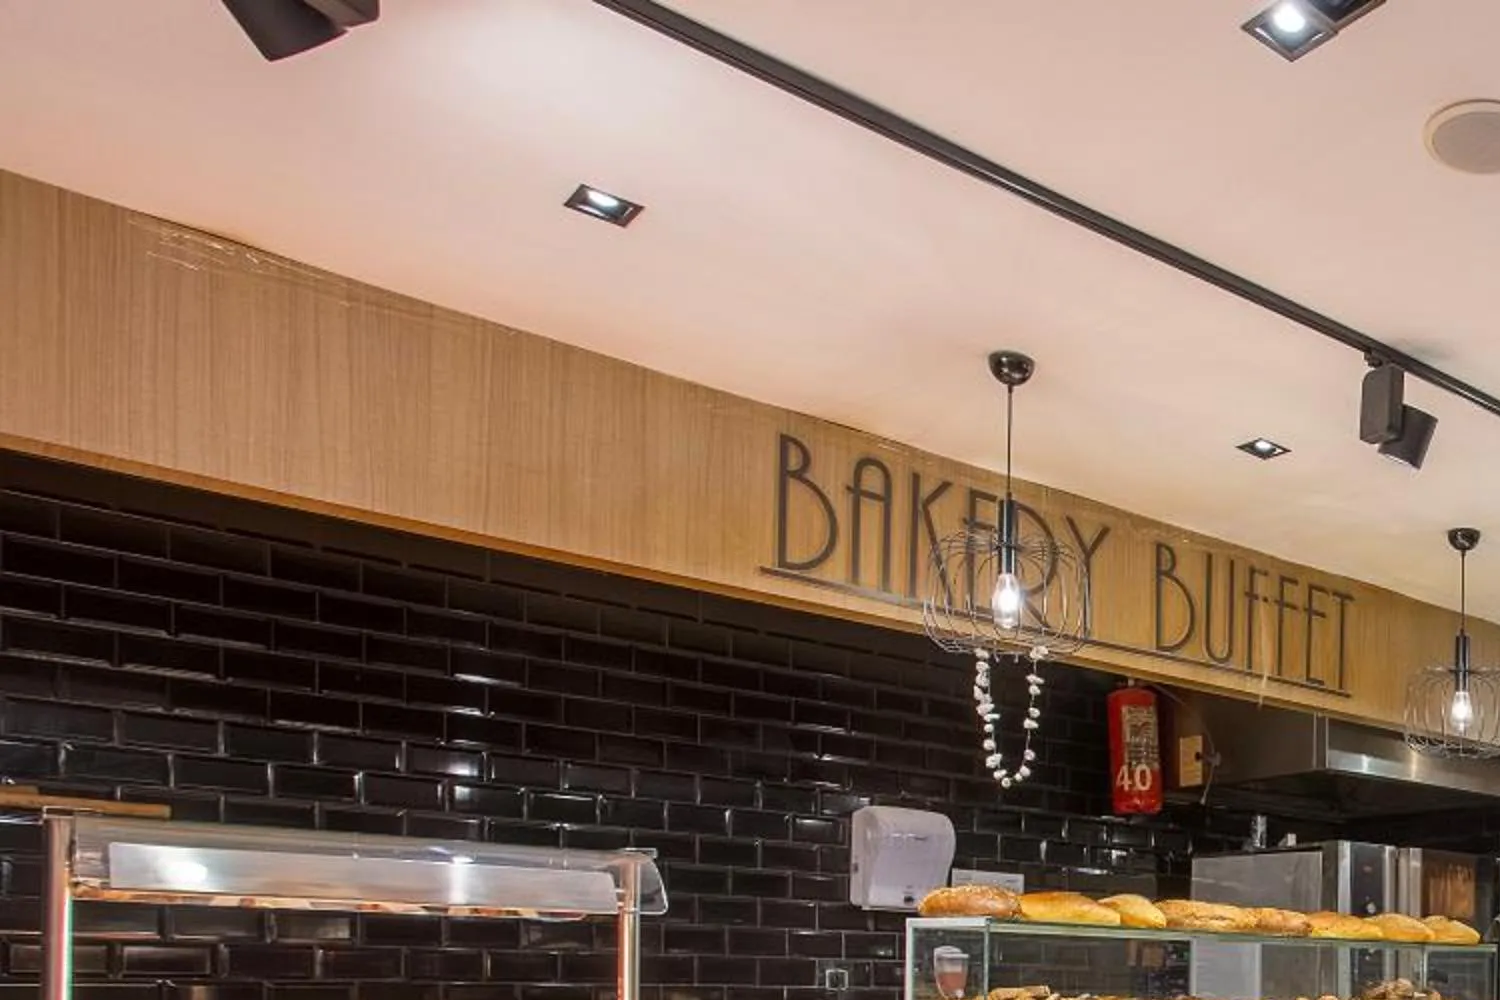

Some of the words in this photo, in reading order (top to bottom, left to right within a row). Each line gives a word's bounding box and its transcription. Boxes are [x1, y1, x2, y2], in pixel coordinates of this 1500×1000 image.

[776, 432, 1111, 641] BAKERY
[1154, 541, 1355, 690] BUFFET
[1116, 763, 1153, 791] 40
